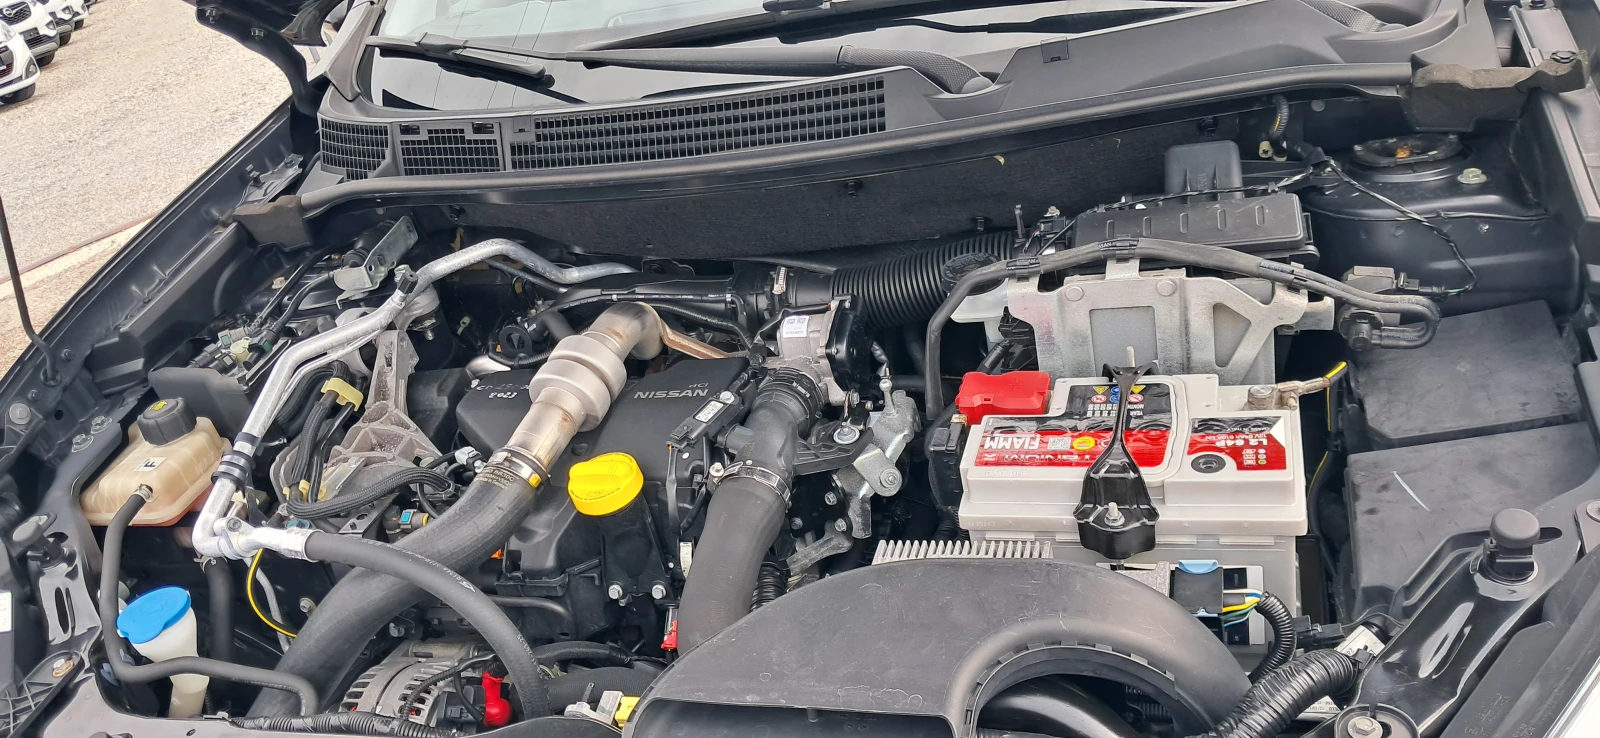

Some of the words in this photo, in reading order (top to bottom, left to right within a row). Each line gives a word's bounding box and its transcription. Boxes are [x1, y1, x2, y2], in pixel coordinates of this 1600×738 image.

[634, 388, 709, 399] NISSAN
[984, 437, 1040, 450] FIAMM
[1216, 439, 1245, 447] 64P
[1249, 438, 1268, 446] L2
